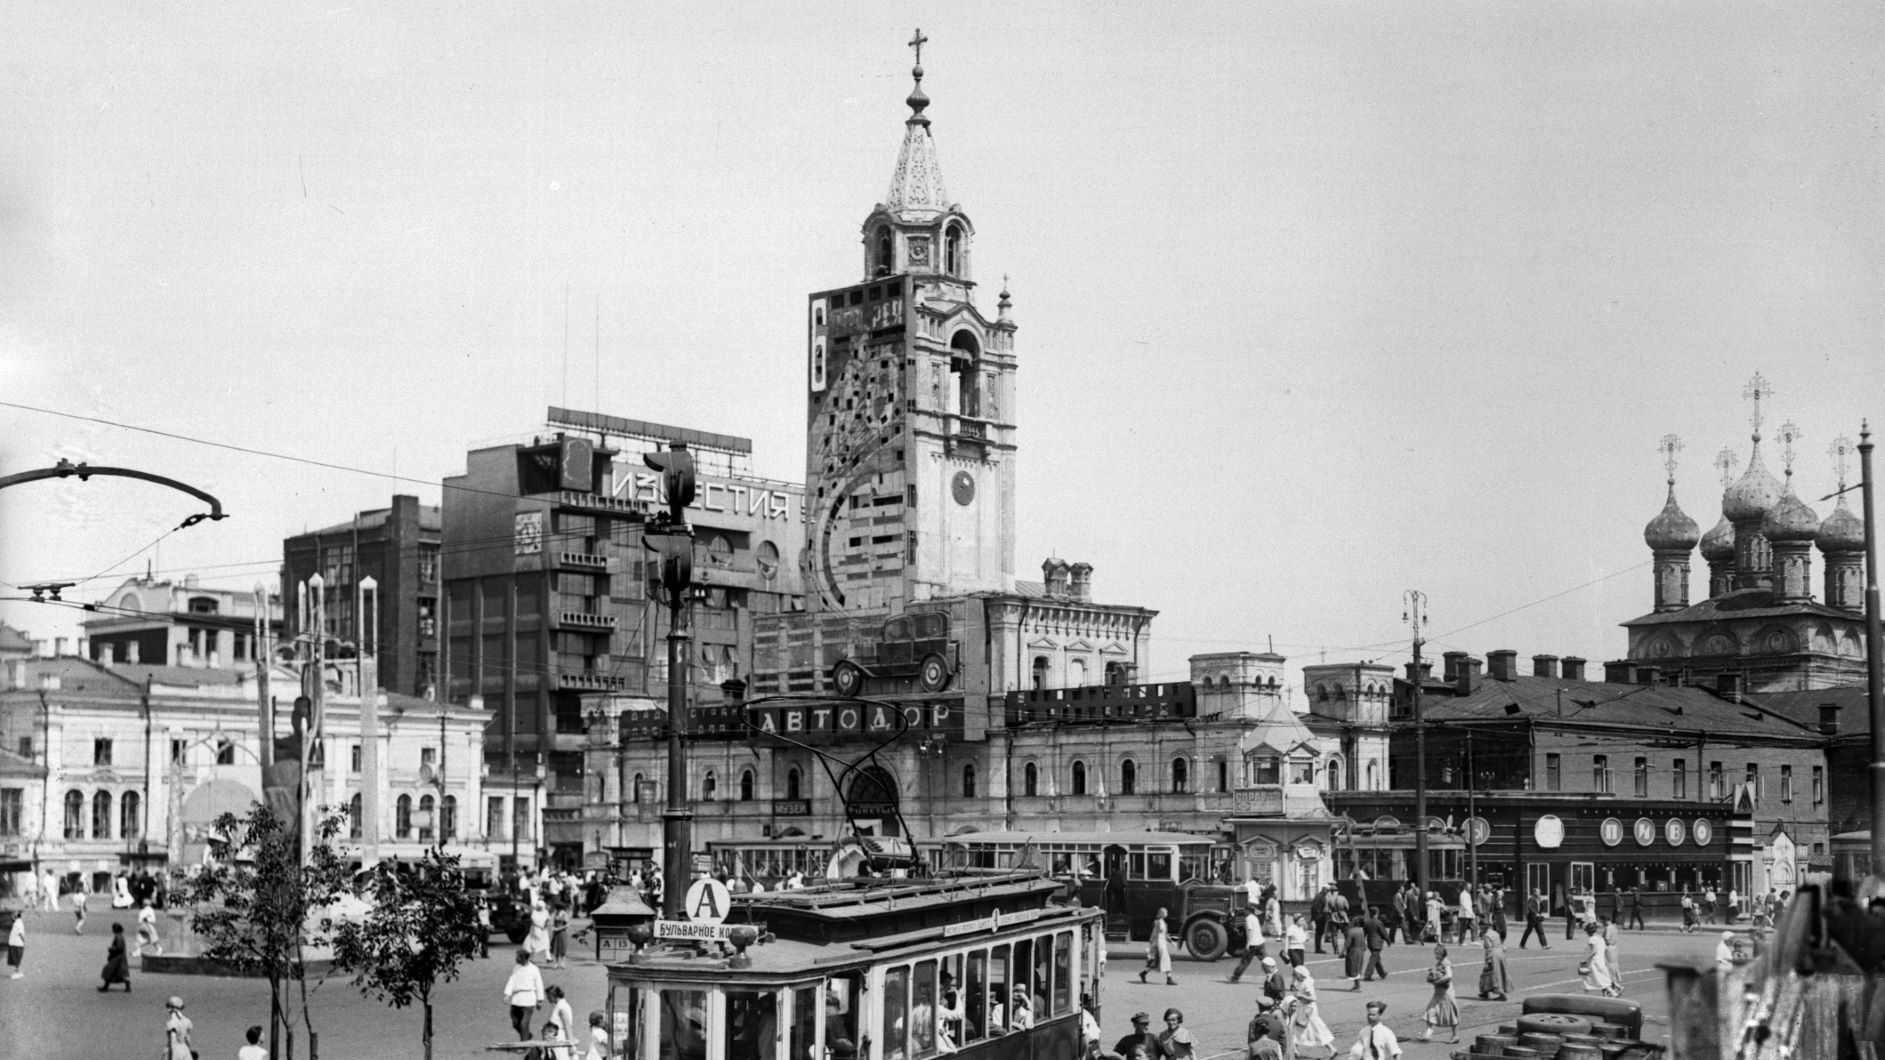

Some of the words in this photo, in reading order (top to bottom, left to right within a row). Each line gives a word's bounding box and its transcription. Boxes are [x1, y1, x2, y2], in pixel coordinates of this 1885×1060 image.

[761, 704, 949, 734] АВТОДОР
[1604, 822, 1707, 842] ПИВО
[694, 883, 721, 918] А
[659, 923, 715, 938] БУЛЬВАРНОЕ
